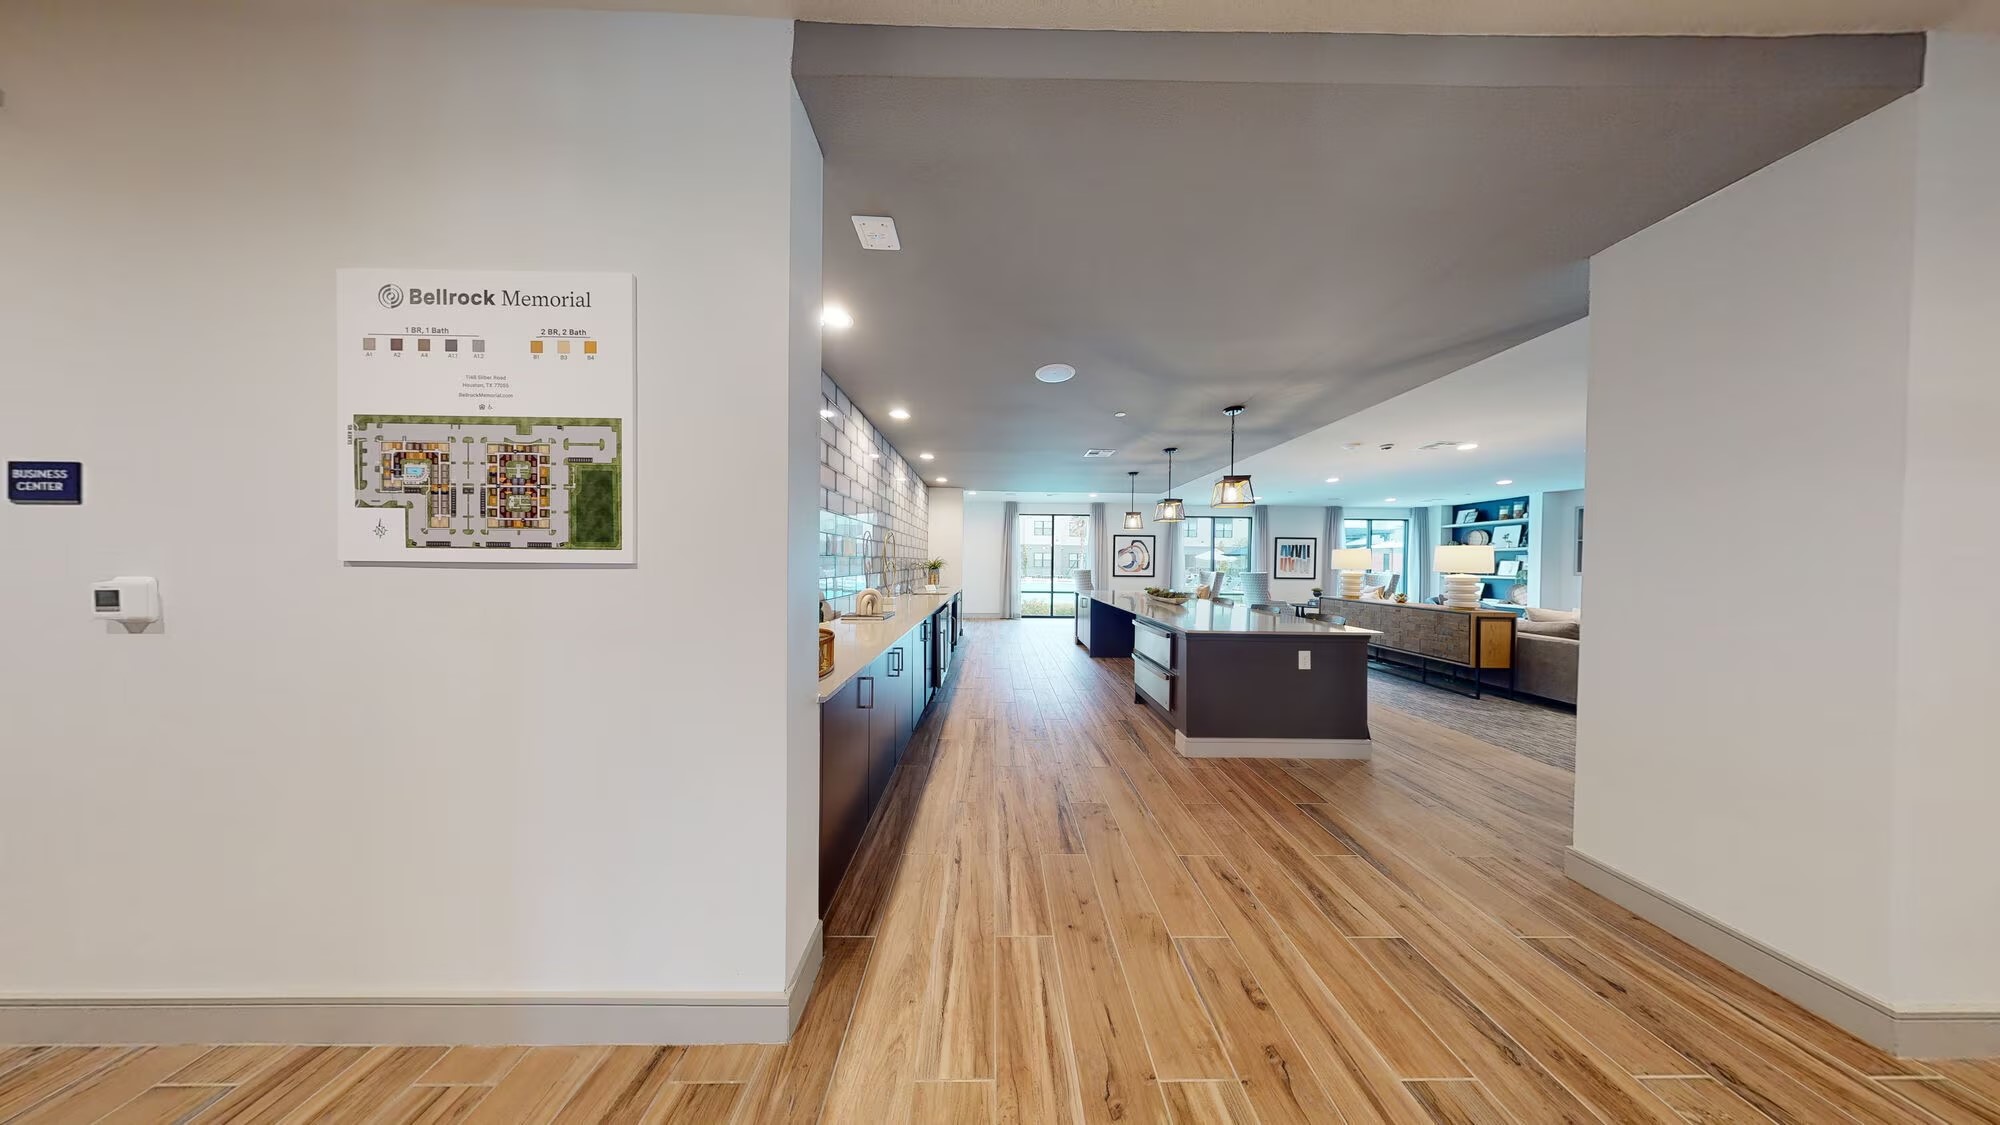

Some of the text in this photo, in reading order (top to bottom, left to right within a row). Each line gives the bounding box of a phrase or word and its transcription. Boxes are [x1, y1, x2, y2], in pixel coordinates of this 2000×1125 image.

[409, 288, 592, 308] Bellrock Memorial
[12, 469, 68, 478] BUSINESS
[16, 482, 64, 491] CENTER
